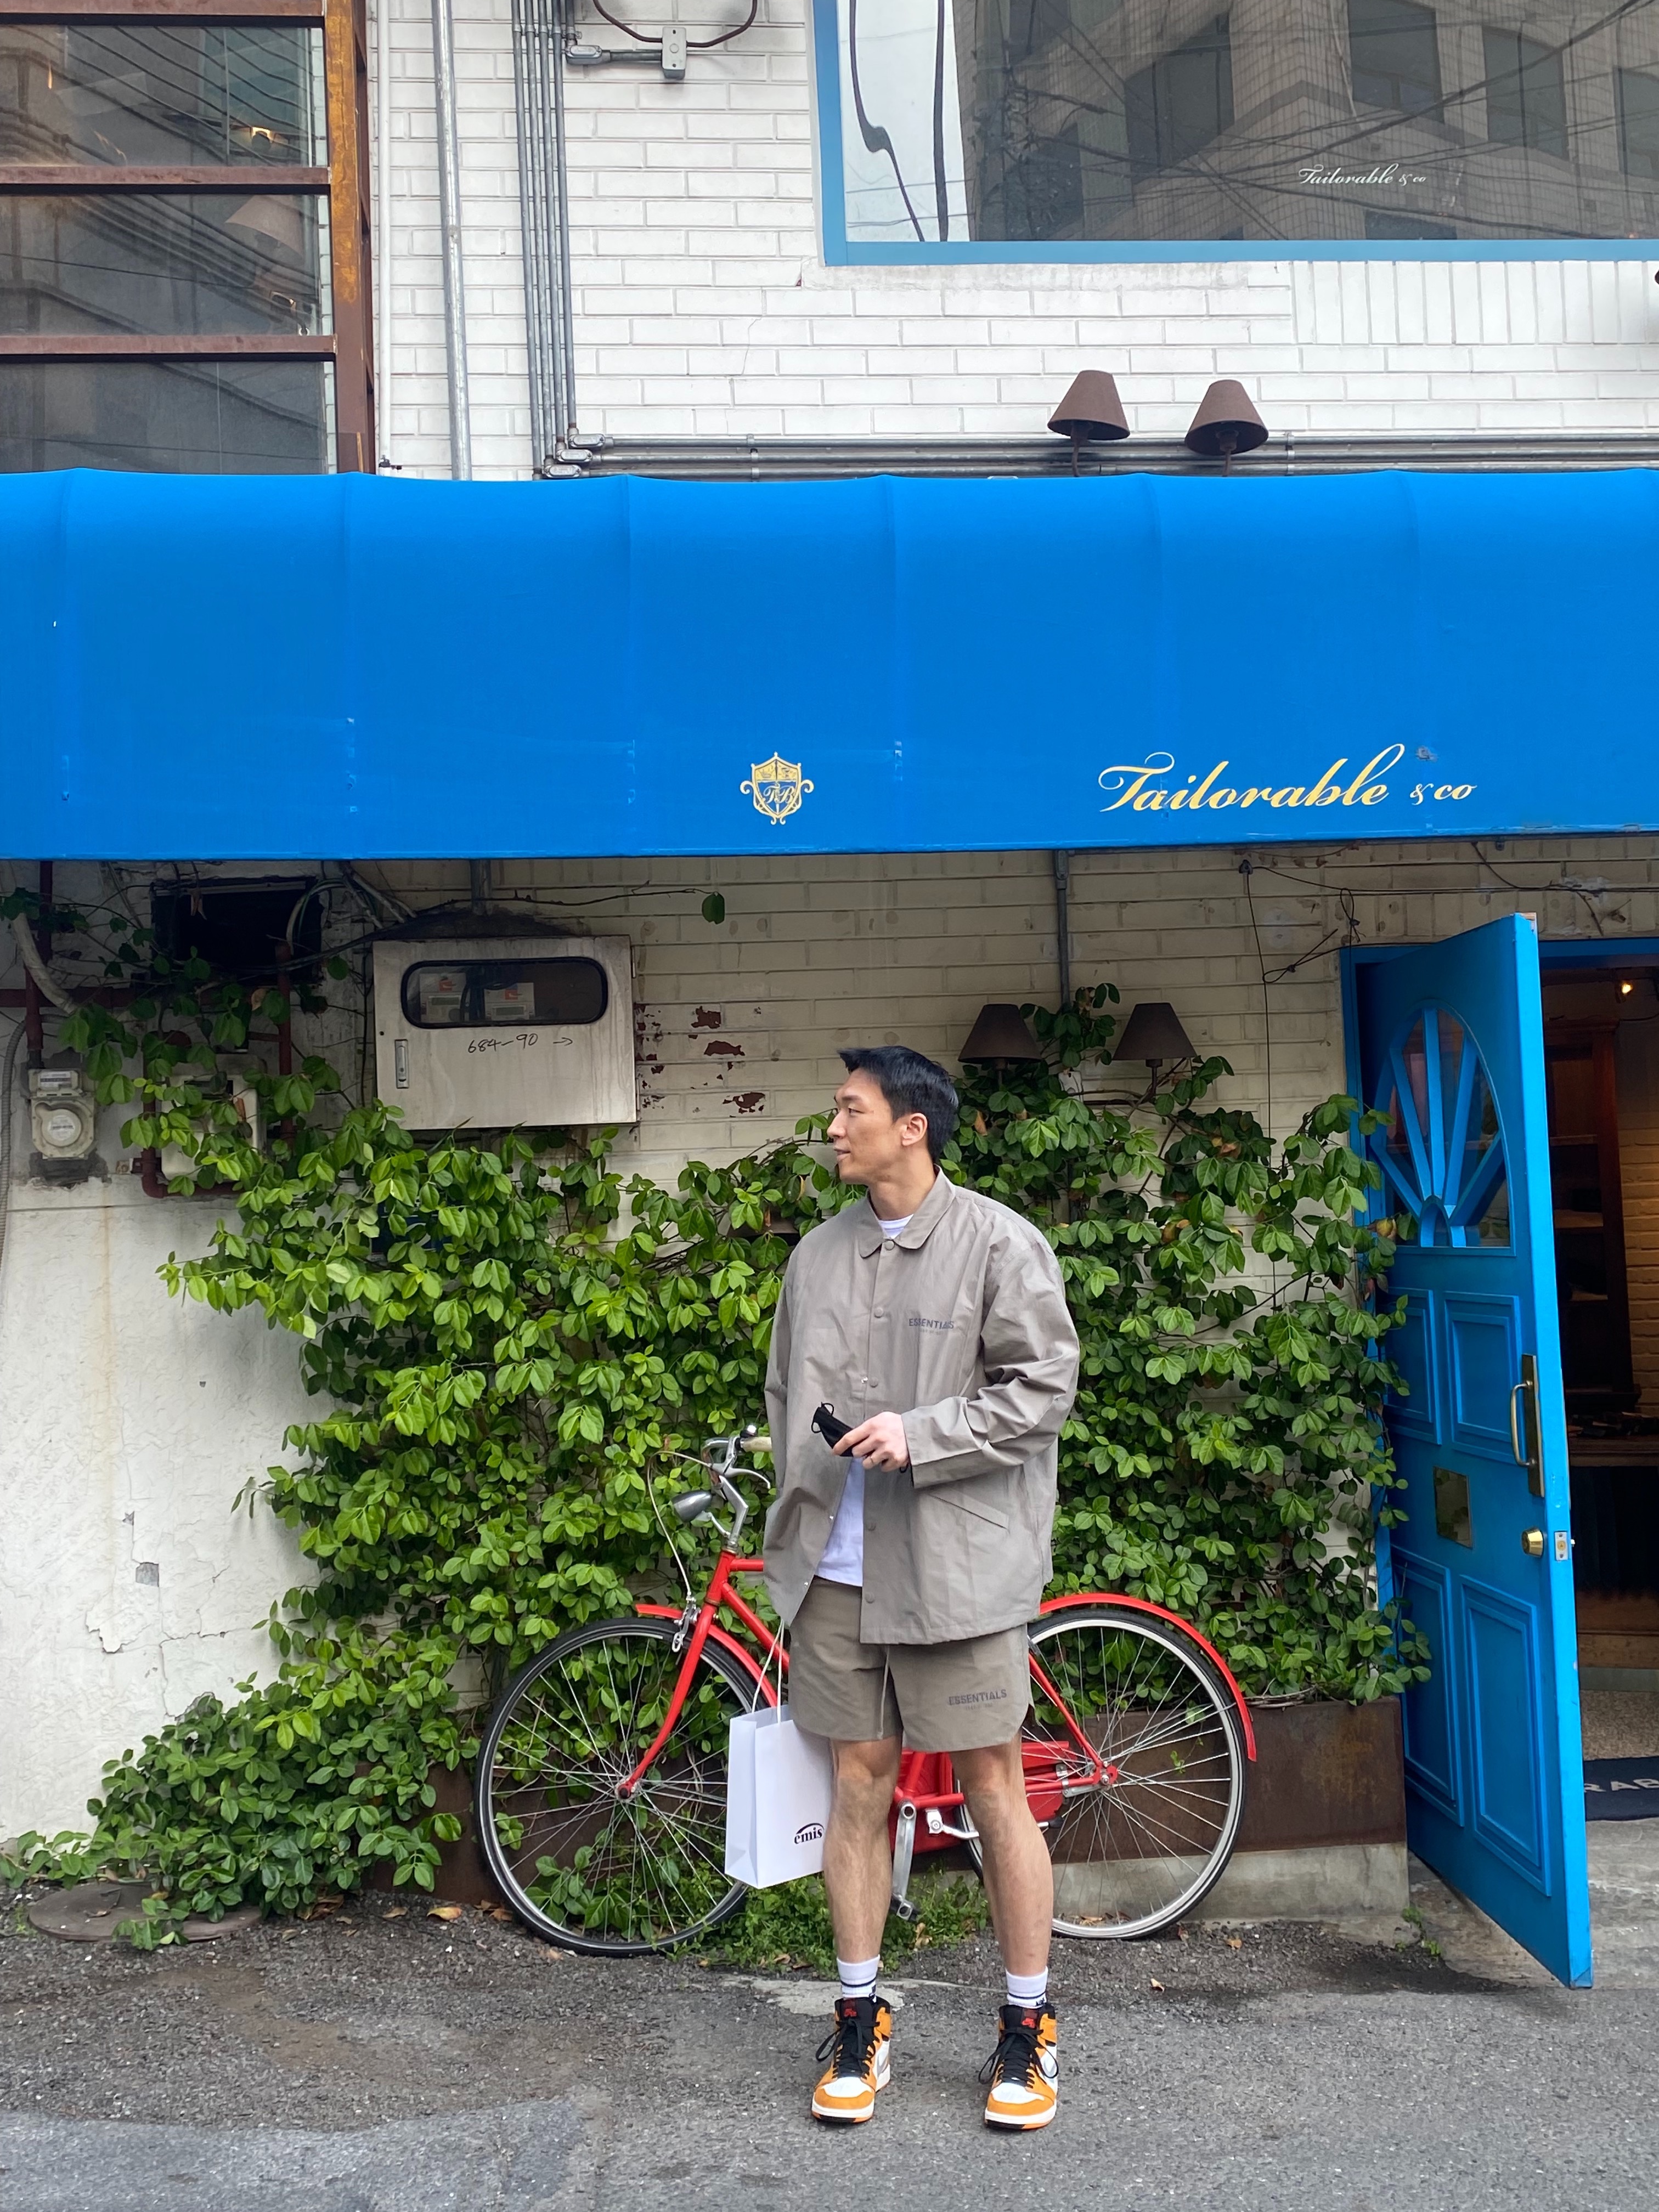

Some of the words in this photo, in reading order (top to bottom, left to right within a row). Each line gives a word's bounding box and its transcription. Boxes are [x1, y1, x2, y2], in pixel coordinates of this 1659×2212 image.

[1299, 163, 1399, 184] Tailorable
[1098, 743, 1405, 812] Tailorable
[467, 1033, 539, 1054] 684-90
[948, 1689, 1007, 1706] ESSENTIALS
[794, 1827, 823, 1845] emis
